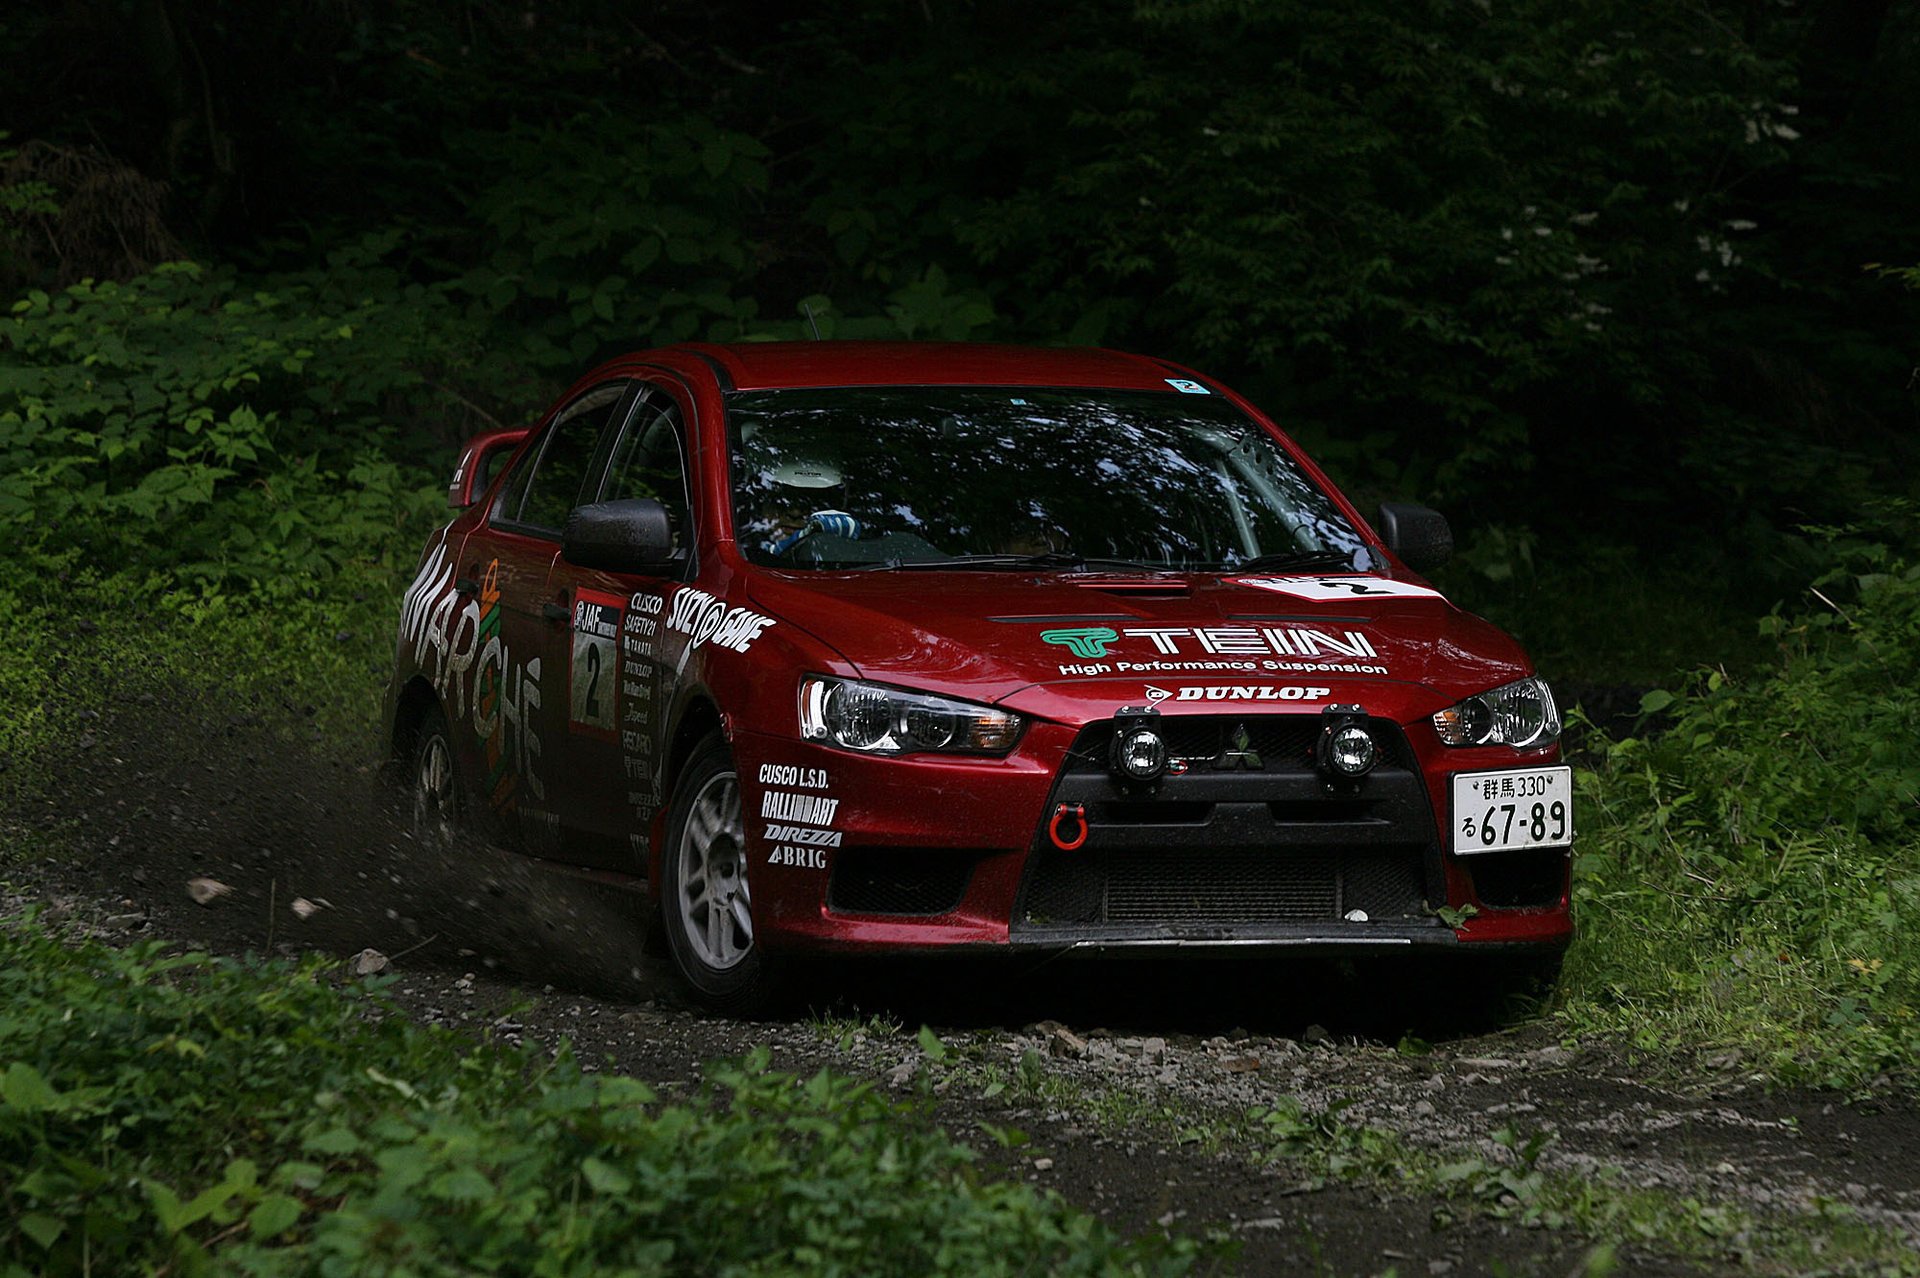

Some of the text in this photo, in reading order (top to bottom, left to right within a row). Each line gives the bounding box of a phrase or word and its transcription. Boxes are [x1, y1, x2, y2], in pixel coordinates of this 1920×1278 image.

[1318, 582, 1396, 595] 2
[631, 592, 663, 615] CUSCO
[581, 603, 602, 632] JAF
[631, 639, 652, 657] TAKATA
[1122, 628, 1377, 657] TEIN
[587, 642, 600, 718] 2
[624, 660, 652, 678] DUNLOP
[1059, 660, 1388, 676] High Performance Suspension
[1177, 686, 1330, 701] DUNLOP
[759, 763, 829, 789] CUSCO L.S.D.
[1483, 775, 1546, 800] 群馬 330
[763, 823, 843, 848] DIREZZA
[1462, 801, 1565, 845] る 67-89
[767, 844, 827, 869] ABRIG
